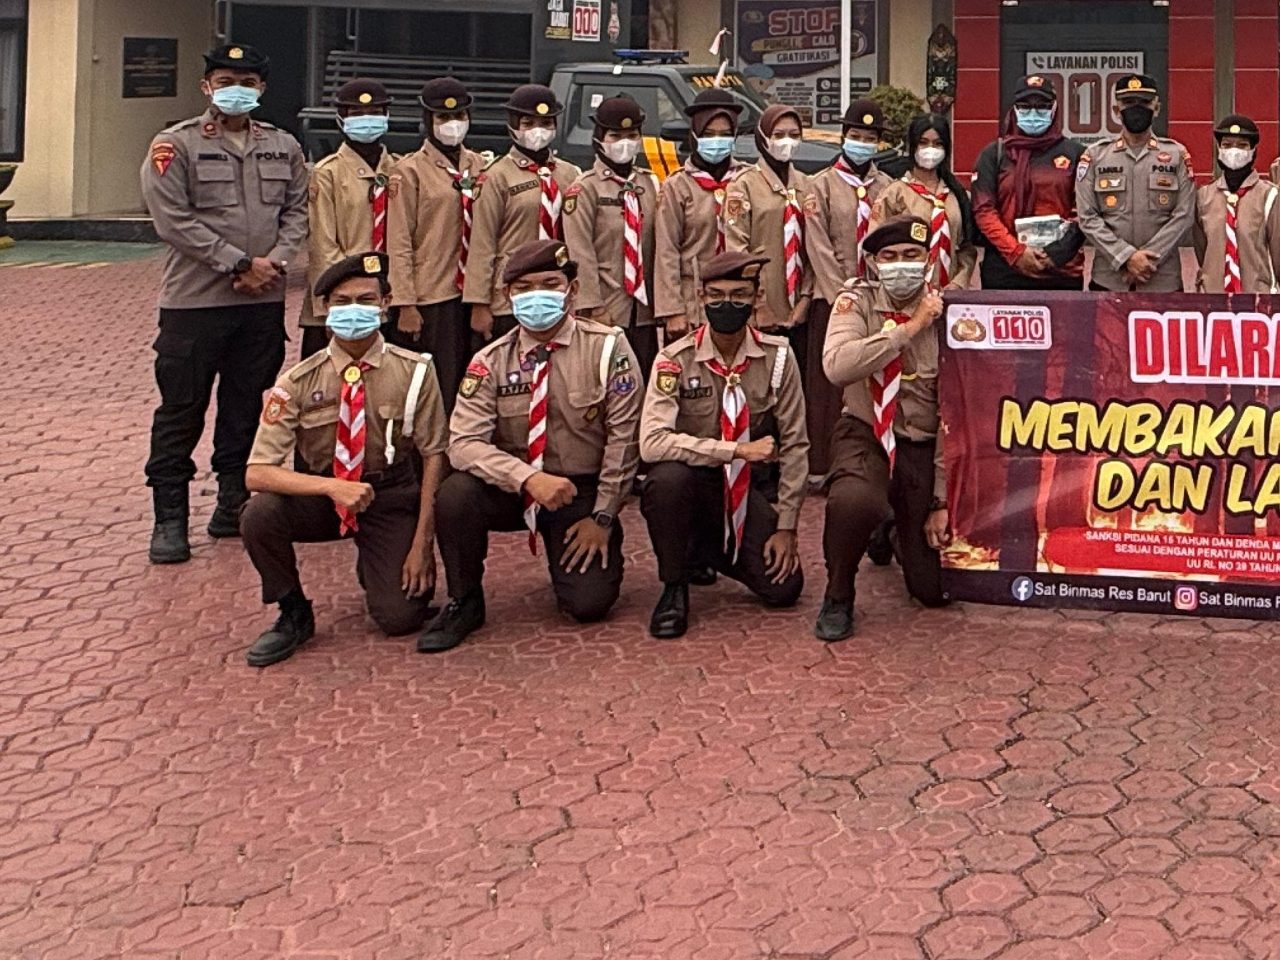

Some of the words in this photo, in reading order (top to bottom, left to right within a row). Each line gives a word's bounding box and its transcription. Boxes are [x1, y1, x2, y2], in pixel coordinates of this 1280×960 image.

[574, 9, 599, 33] 110
[768, 6, 841, 36] STOP
[1046, 55, 1098, 69] LAYANAN
[1100, 55, 1139, 69] POLISI
[995, 317, 1044, 339] 110
[1095, 458, 1214, 513] DAN
[1123, 533, 1161, 544] PIDANA
[1175, 536, 1209, 547] TAHUN
[1211, 537, 1234, 548] DAN
[1235, 538, 1270, 549] DENDA
[1114, 544, 1151, 554] SESUAI
[1152, 545, 1195, 556] DENGAN
[1197, 547, 1259, 561] PERATURAN
[1259, 551, 1274, 562] UU
[1186, 558, 1201, 568] UU
[1217, 560, 1234, 570] NO
[1034, 581, 1056, 596] Sat
[1059, 582, 1105, 599] Binmas
[1108, 586, 1134, 601] Res
[1137, 587, 1171, 603] Barut
[1199, 591, 1221, 606] Sat
[1224, 592, 1271, 609] Binmas
